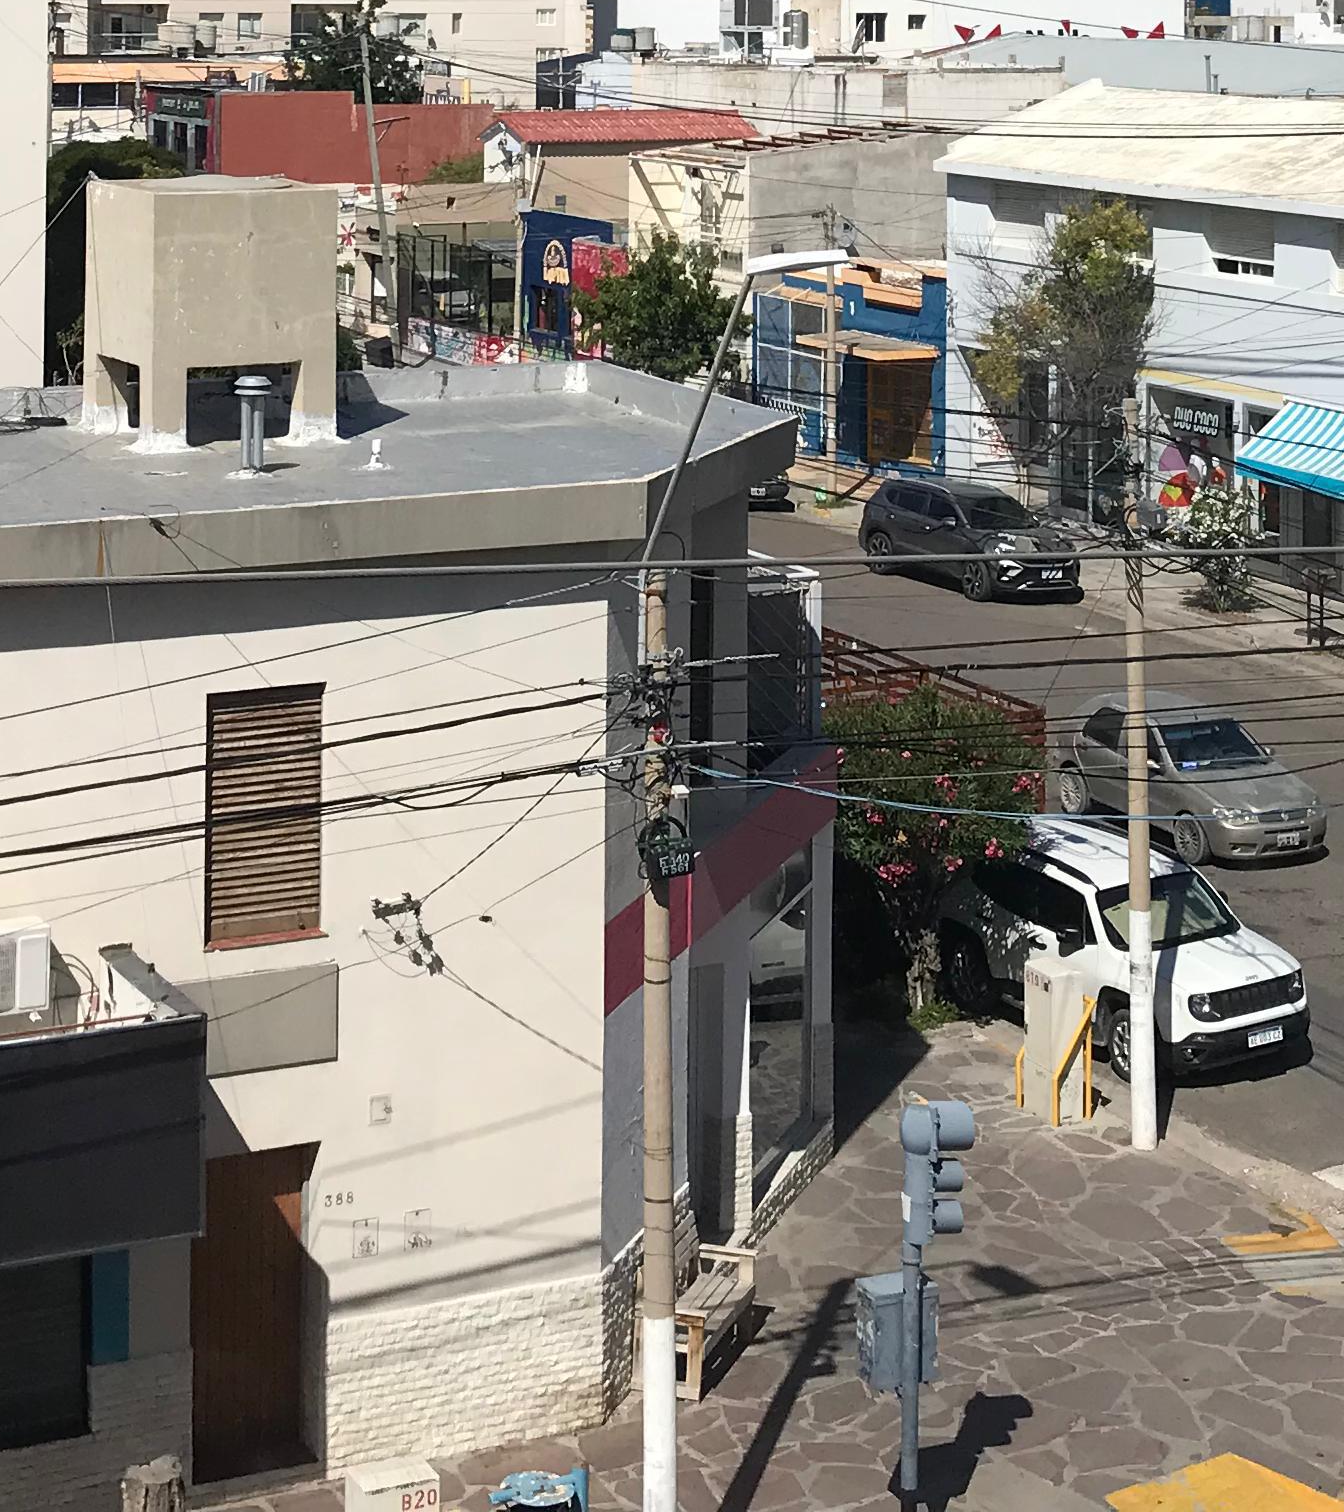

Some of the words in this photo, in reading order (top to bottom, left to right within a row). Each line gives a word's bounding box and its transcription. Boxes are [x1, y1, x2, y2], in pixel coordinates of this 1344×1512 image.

[1173, 406, 1193, 430] DUO
[1194, 410, 1219, 436] COCO
[324, 1191, 354, 1208] 388
[402, 1488, 438, 1511] B20
